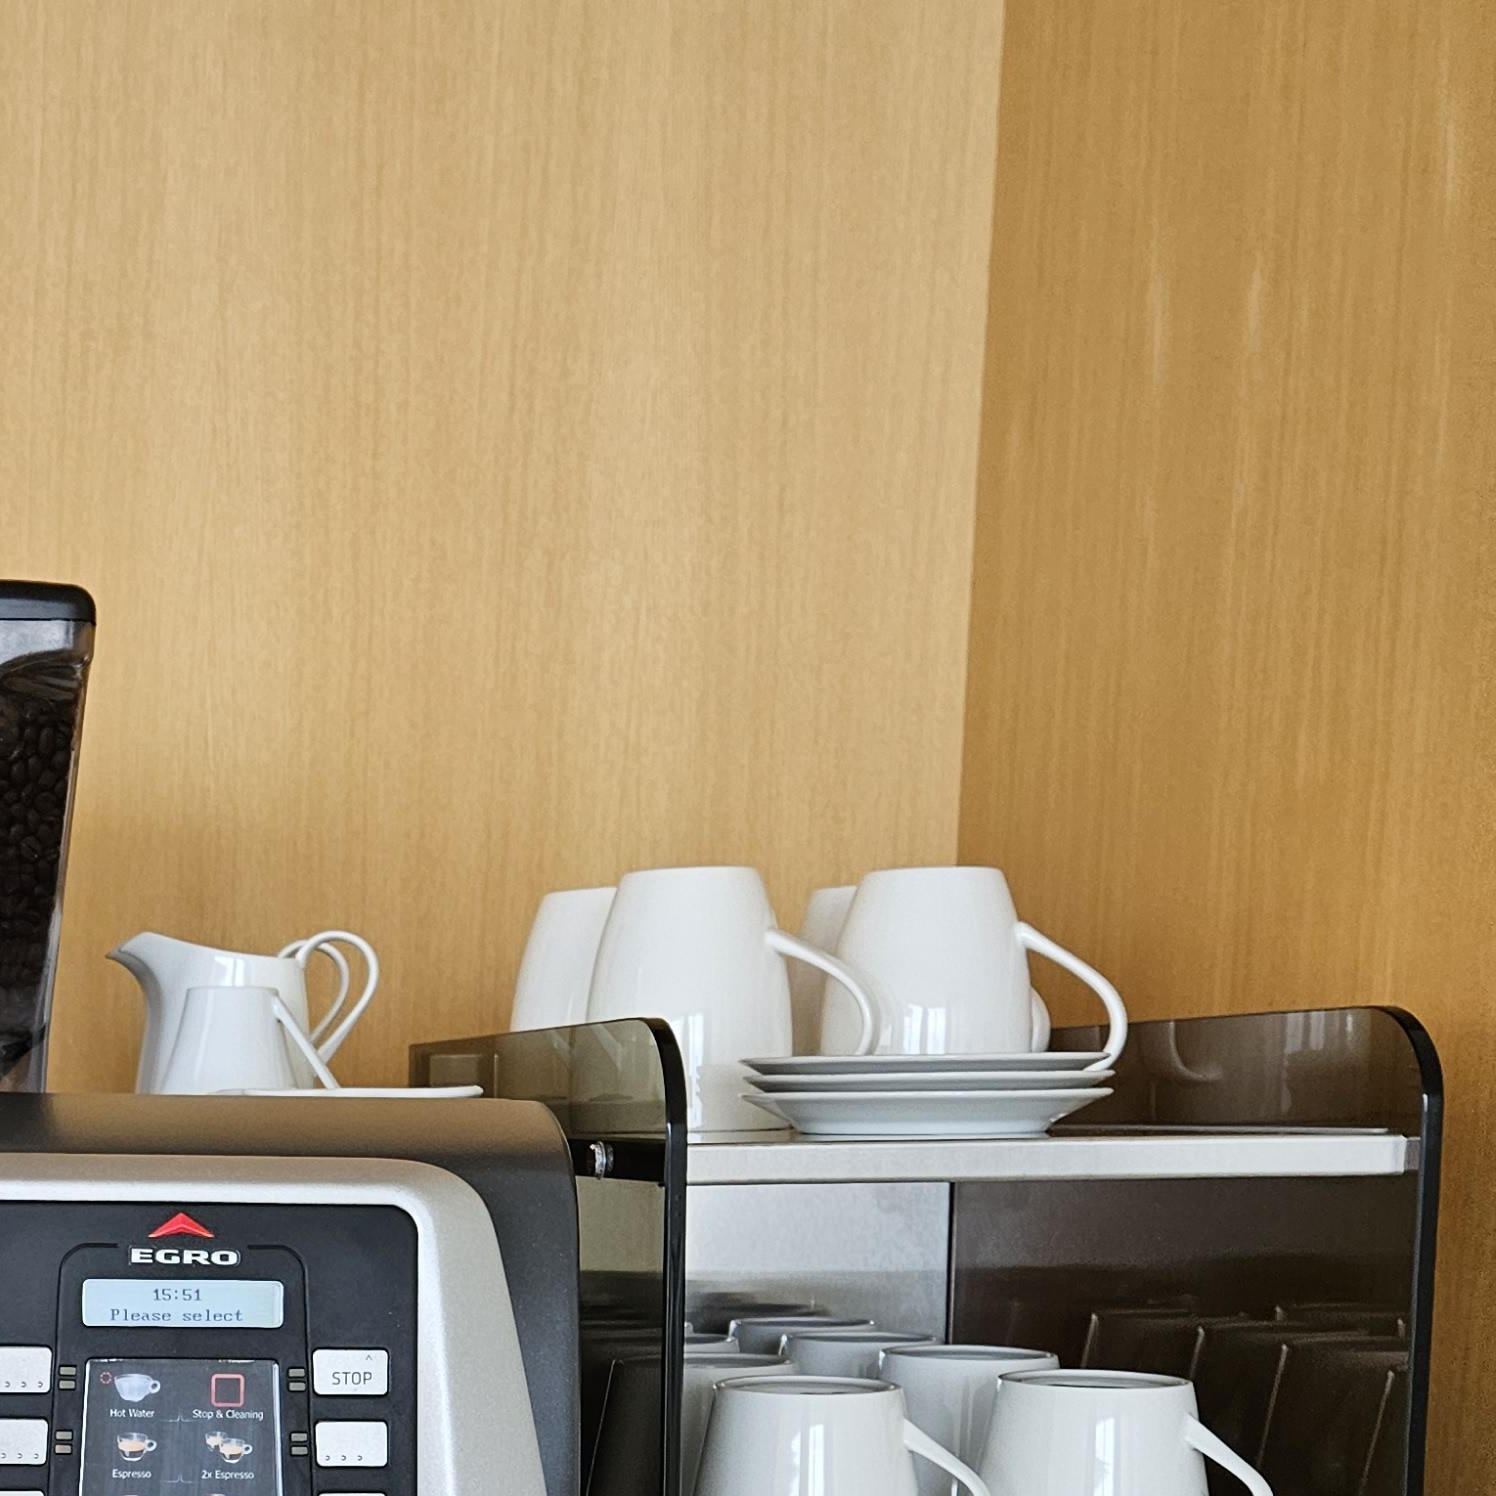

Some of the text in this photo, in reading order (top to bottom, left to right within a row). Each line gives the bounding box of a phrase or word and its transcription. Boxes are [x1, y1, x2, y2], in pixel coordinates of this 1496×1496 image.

[130, 1247, 239, 1266] EGRO
[153, 1287, 203, 1302] 15:51
[109, 1308, 244, 1323] Please select
[331, 1371, 373, 1386] STOP
[109, 1408, 155, 1418] Hot Water
[192, 1408, 264, 1422] Stop & Cleaning
[111, 1468, 152, 1480] Espresso
[201, 1469, 255, 1481] 2x Espresso
